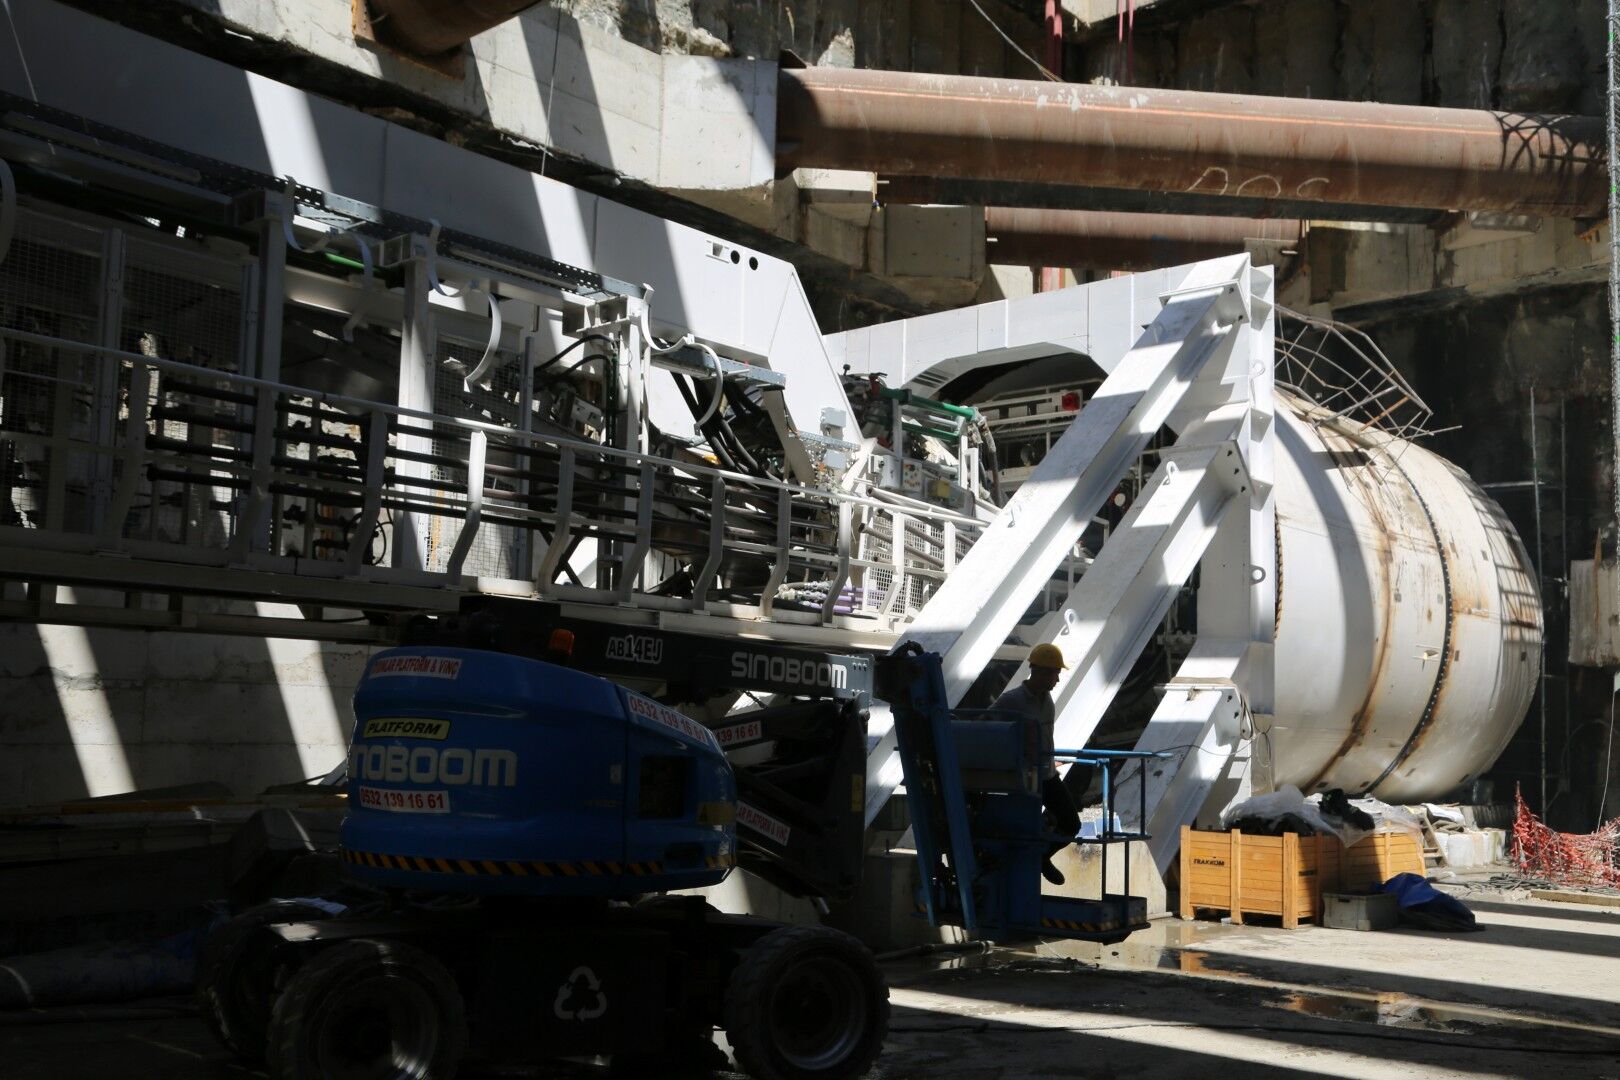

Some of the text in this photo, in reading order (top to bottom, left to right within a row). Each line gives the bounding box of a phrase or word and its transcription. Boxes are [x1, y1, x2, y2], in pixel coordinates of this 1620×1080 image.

[606, 634, 663, 664] AB14EJ
[731, 651, 848, 689] SINOBOOM
[629, 696, 657, 720] 0532
[367, 720, 443, 735] PLATFORM
[735, 725, 746, 738] 16
[748, 722, 759, 737] 61
[360, 788, 444, 809] 0532 139 16 61
